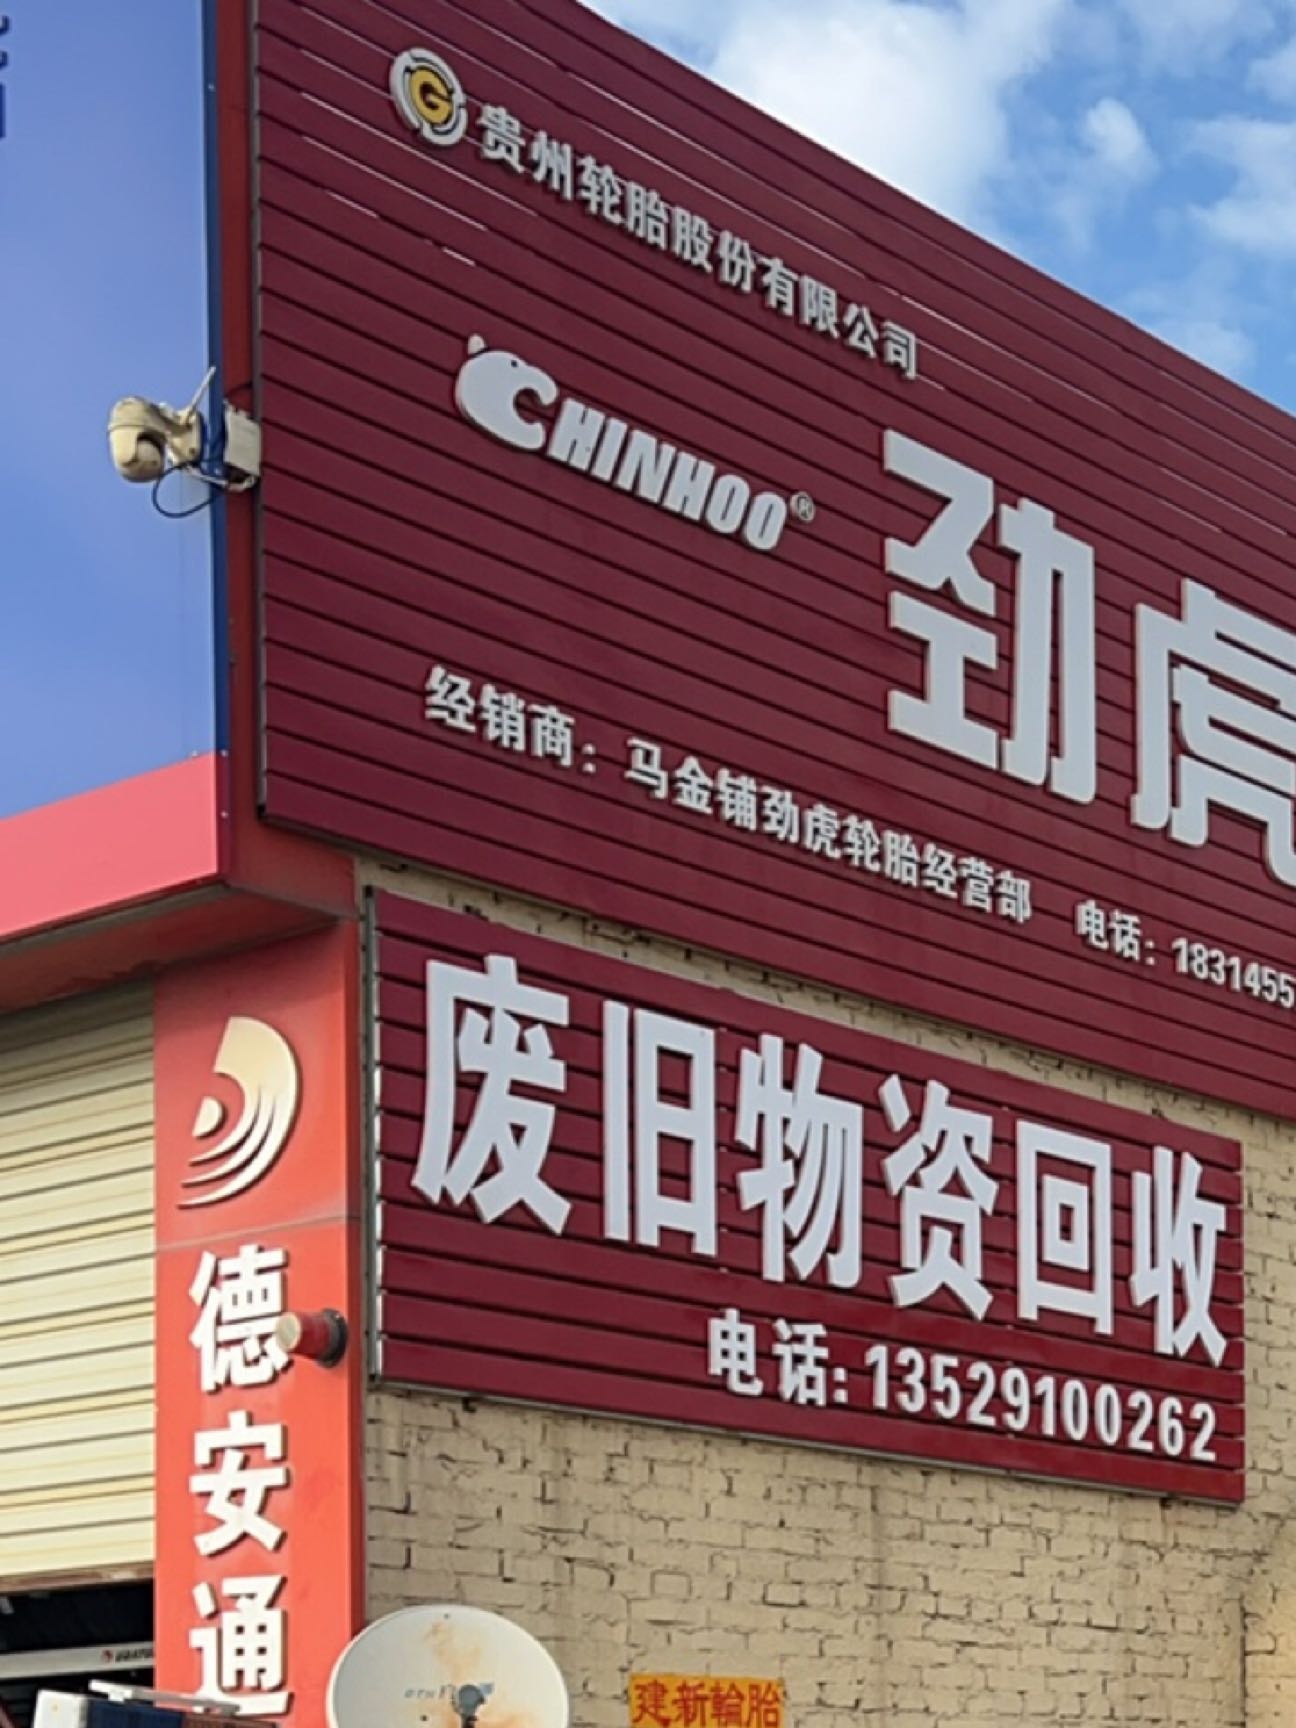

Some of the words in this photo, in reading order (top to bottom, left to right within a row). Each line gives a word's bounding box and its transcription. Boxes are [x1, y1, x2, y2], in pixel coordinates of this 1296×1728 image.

[476, 103, 921, 381] 贵州轮胎股份有限公司
[411, 954, 1228, 1367] 废旧物资回收
[632, 1680, 780, 1728] 建新輪胎
